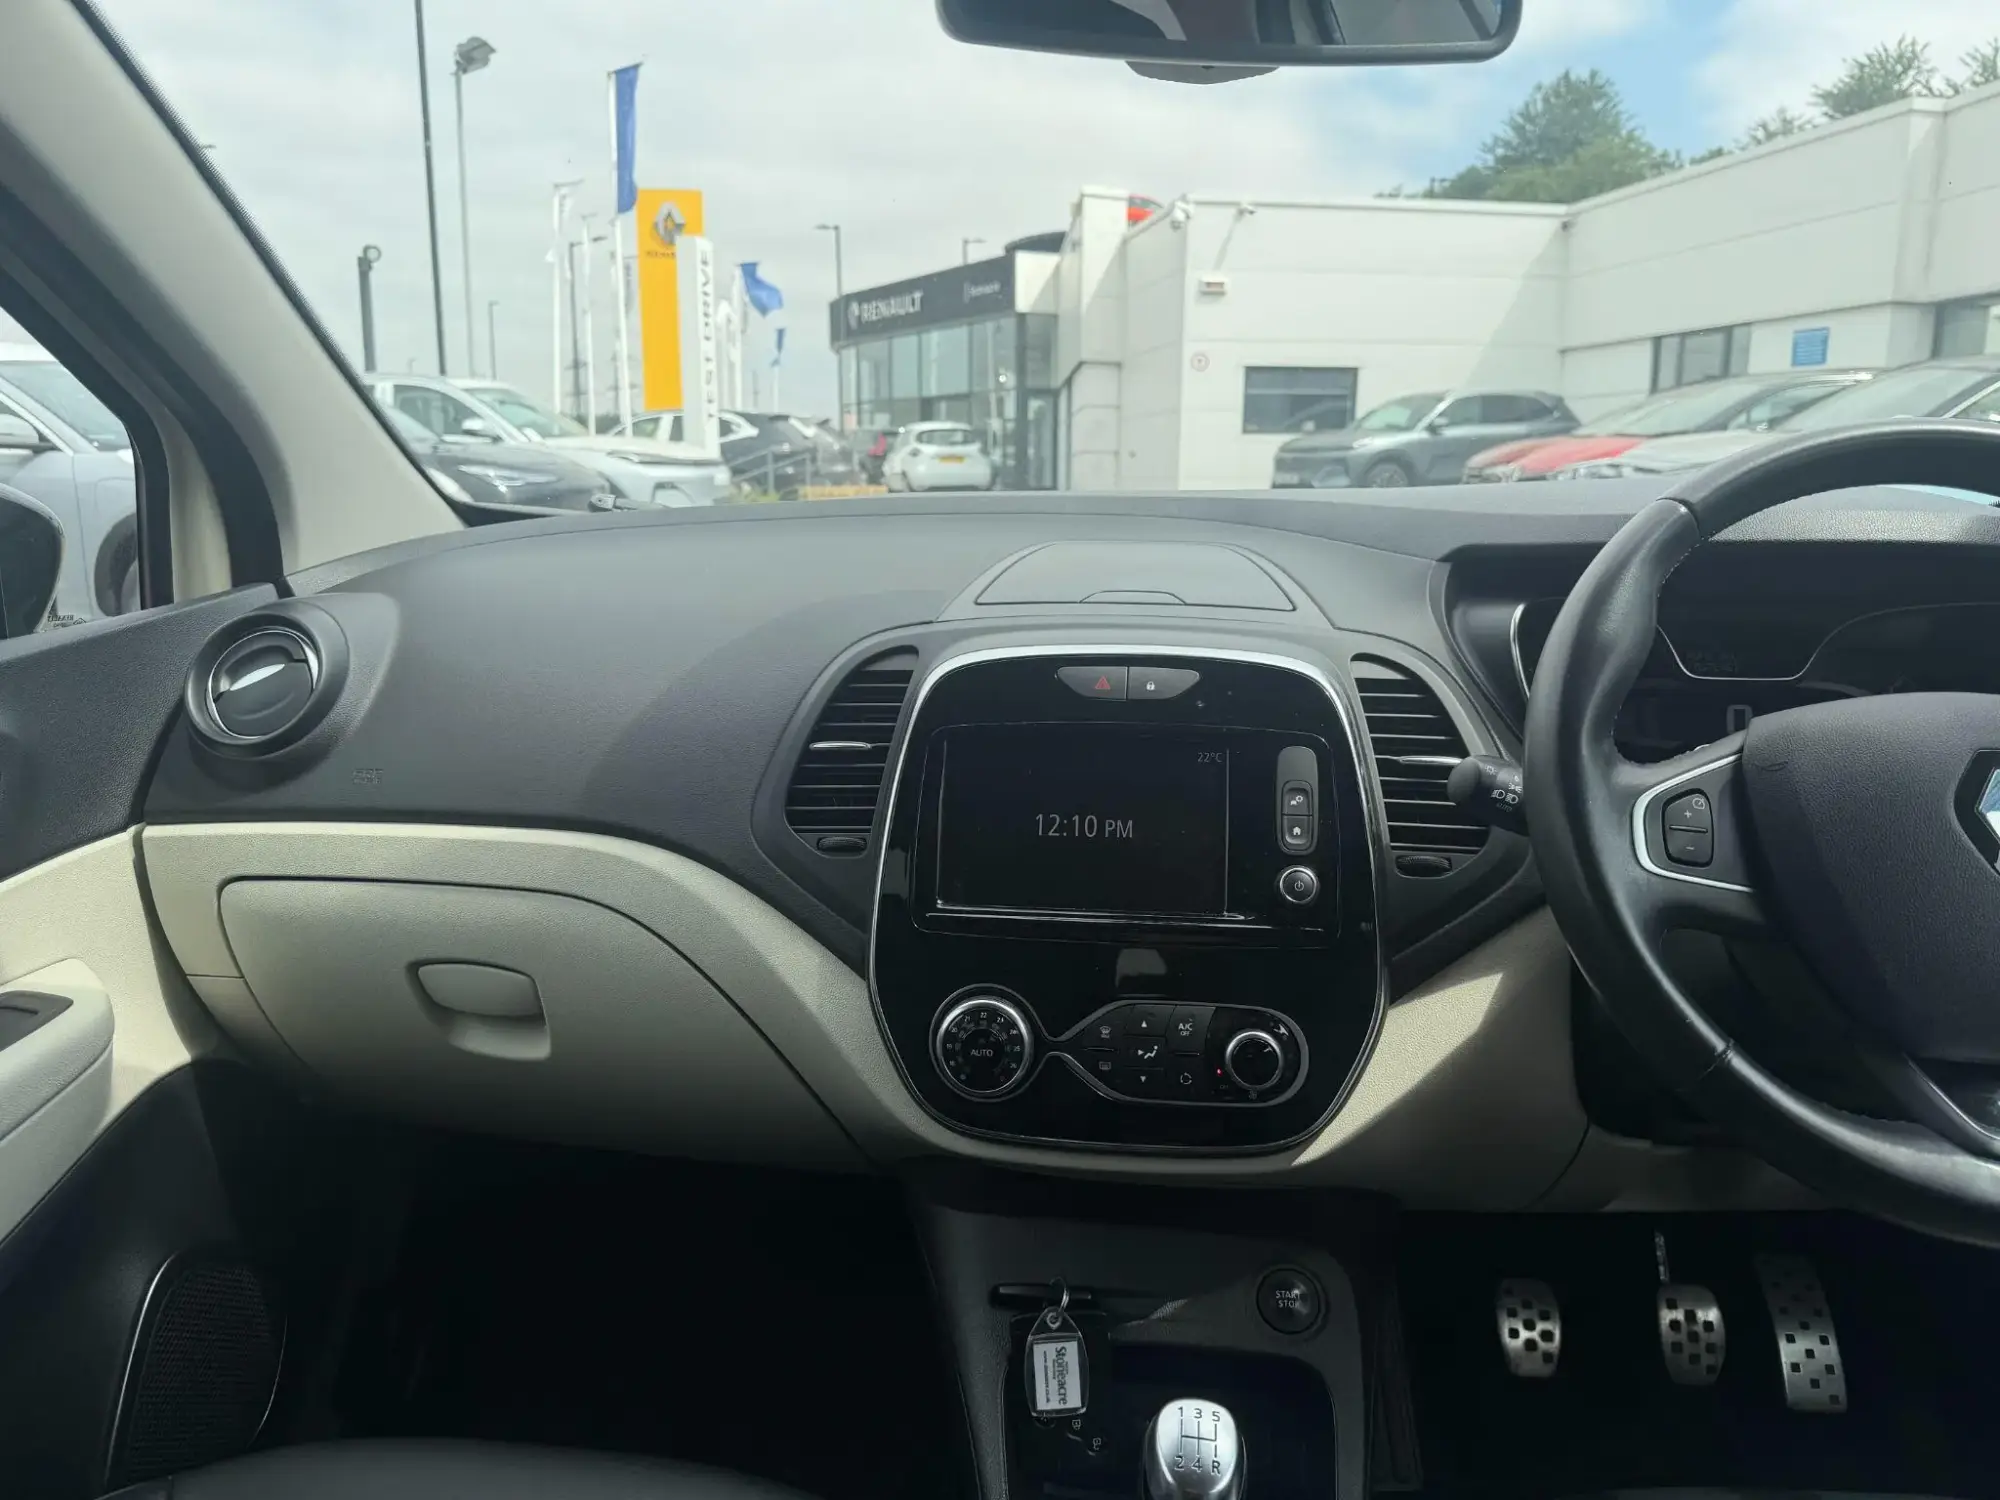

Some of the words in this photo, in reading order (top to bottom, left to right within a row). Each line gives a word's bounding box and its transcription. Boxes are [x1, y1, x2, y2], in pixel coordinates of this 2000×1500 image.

[860, 290, 924, 324] RENAULT
[1035, 814, 1098, 838] 12:10
[1104, 819, 1133, 839] PM
[970, 1049, 994, 1057] AUTO
[1275, 1290, 1300, 1299] START
[1055, 1346, 1067, 1405] Stoneacre
[1178, 1406, 1184, 1418] 1
[1194, 1408, 1202, 1419] 3
[1212, 1411, 1220, 1423] 5
[1174, 1456, 1184, 1471] 2
[1191, 1457, 1202, 1473] 4
[1211, 1459, 1221, 1475] R
